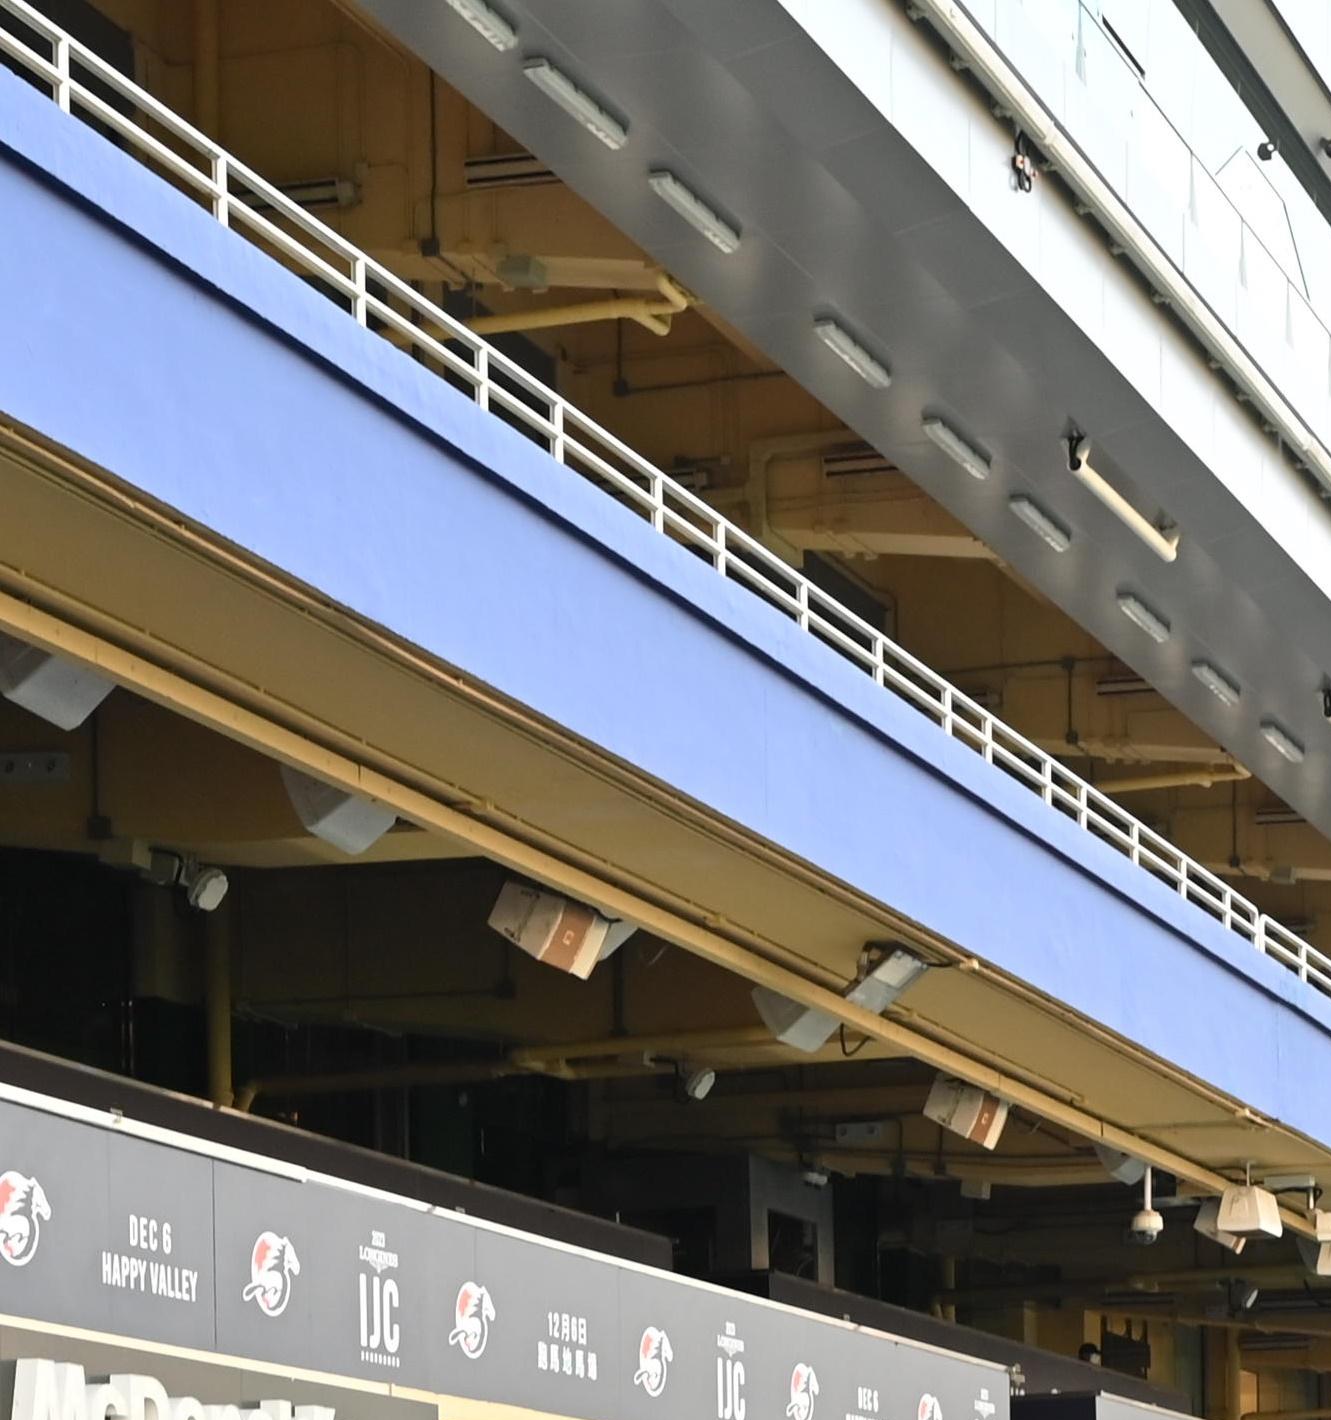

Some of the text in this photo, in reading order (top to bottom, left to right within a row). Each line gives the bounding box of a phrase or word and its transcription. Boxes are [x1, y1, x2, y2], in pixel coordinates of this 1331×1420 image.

[129, 1214, 172, 1254] DEC 6
[102, 1250, 198, 1302] HAPPY VALLEY
[359, 1273, 400, 1353] IJC
